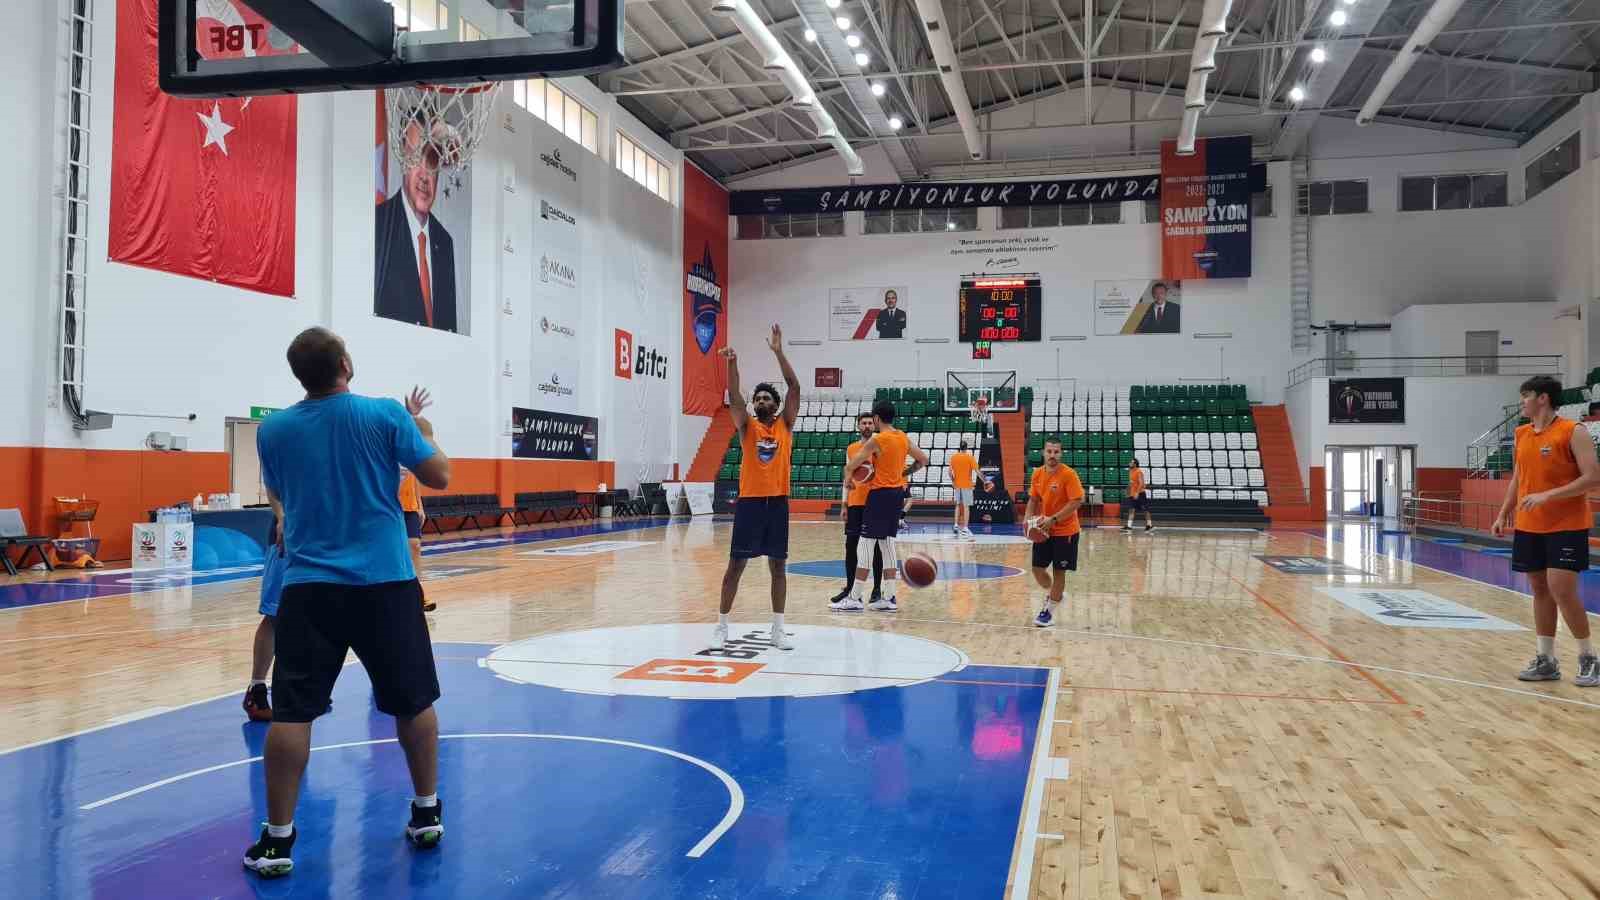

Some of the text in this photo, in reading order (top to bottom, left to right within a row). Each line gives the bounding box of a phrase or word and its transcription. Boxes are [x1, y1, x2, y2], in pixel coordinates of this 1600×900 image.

[1028, 178, 1160, 201] YOLUNDA
[635, 345, 667, 380] Bitci
[535, 438, 575, 453] YOLUNDA
